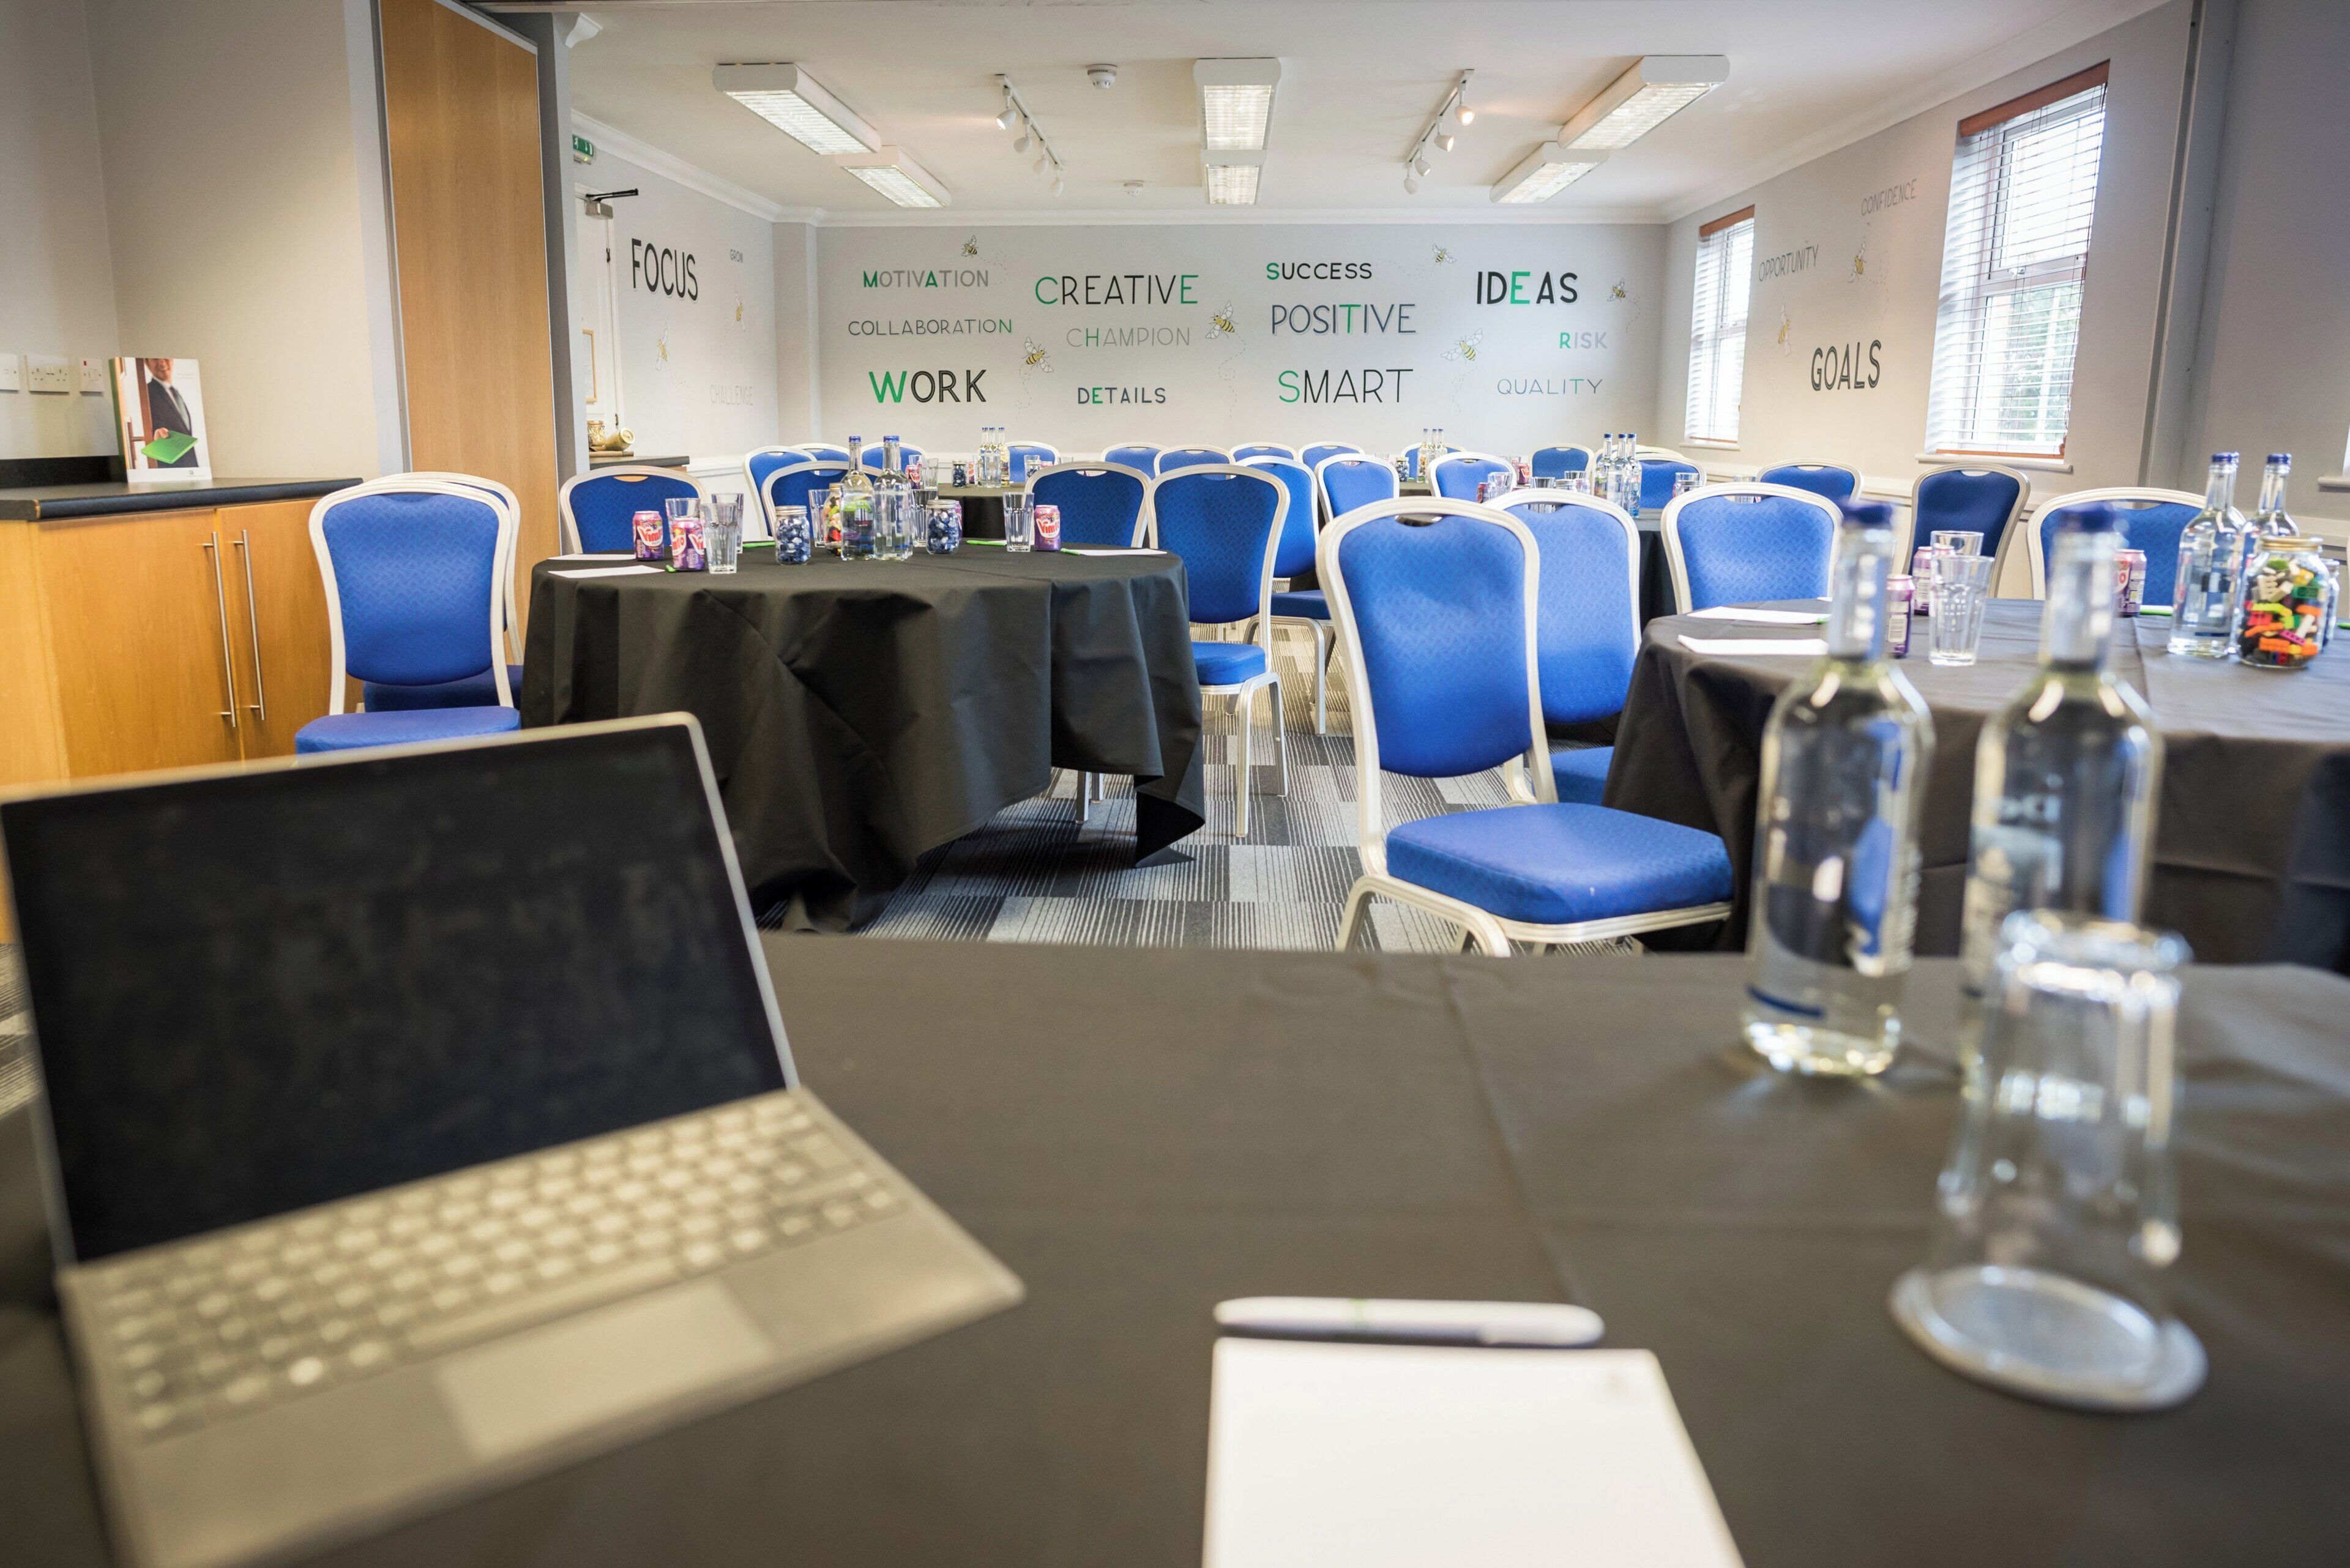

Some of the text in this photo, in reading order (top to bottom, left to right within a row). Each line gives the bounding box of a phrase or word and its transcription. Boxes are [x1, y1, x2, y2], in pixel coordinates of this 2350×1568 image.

[1861, 178, 1917, 217] CONFIDENCE
[631, 238, 698, 302] FOCUS
[1266, 263, 1372, 280] SUCCESS
[1758, 244, 1819, 282] OPPORTUNITY
[863, 270, 989, 288] MOTIVATION
[1035, 275, 1199, 305] CREATIVE
[1477, 271, 1579, 305] IDEAS
[848, 319, 1012, 335] COLLABORATION
[1271, 304, 1417, 335] POSITIVE
[1066, 327, 1190, 348] CHAMPION
[1559, 332, 1608, 349] RISK
[1810, 340, 1882, 391] GOALS
[710, 384, 753, 406] CHALLENGE
[869, 370, 987, 403] WORK
[1077, 387, 1166, 405] DETAILS
[1278, 369, 1414, 403] SMART
[1497, 379, 1603, 395] QUALITY
